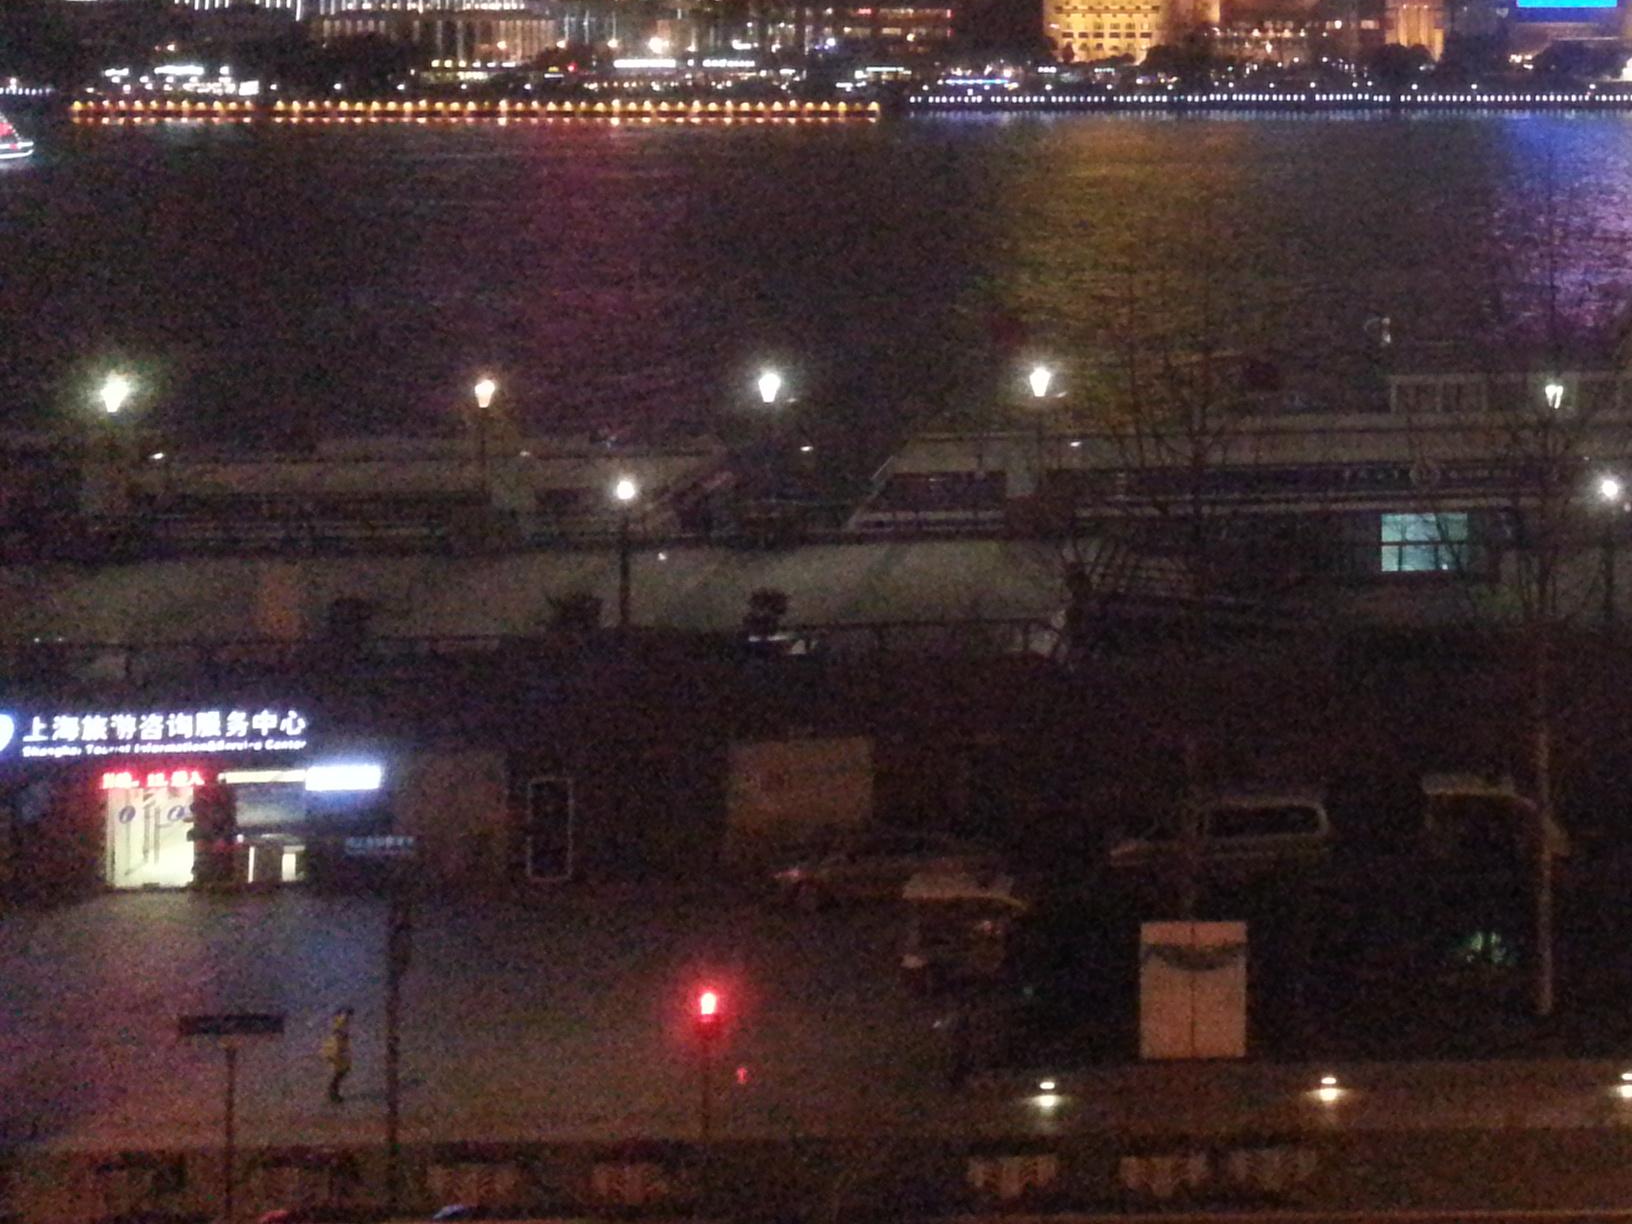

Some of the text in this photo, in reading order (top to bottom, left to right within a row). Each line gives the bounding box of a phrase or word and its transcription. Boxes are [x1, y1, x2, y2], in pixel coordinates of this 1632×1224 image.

[22, 709, 307, 743] 上海旅游咨询服务中心
